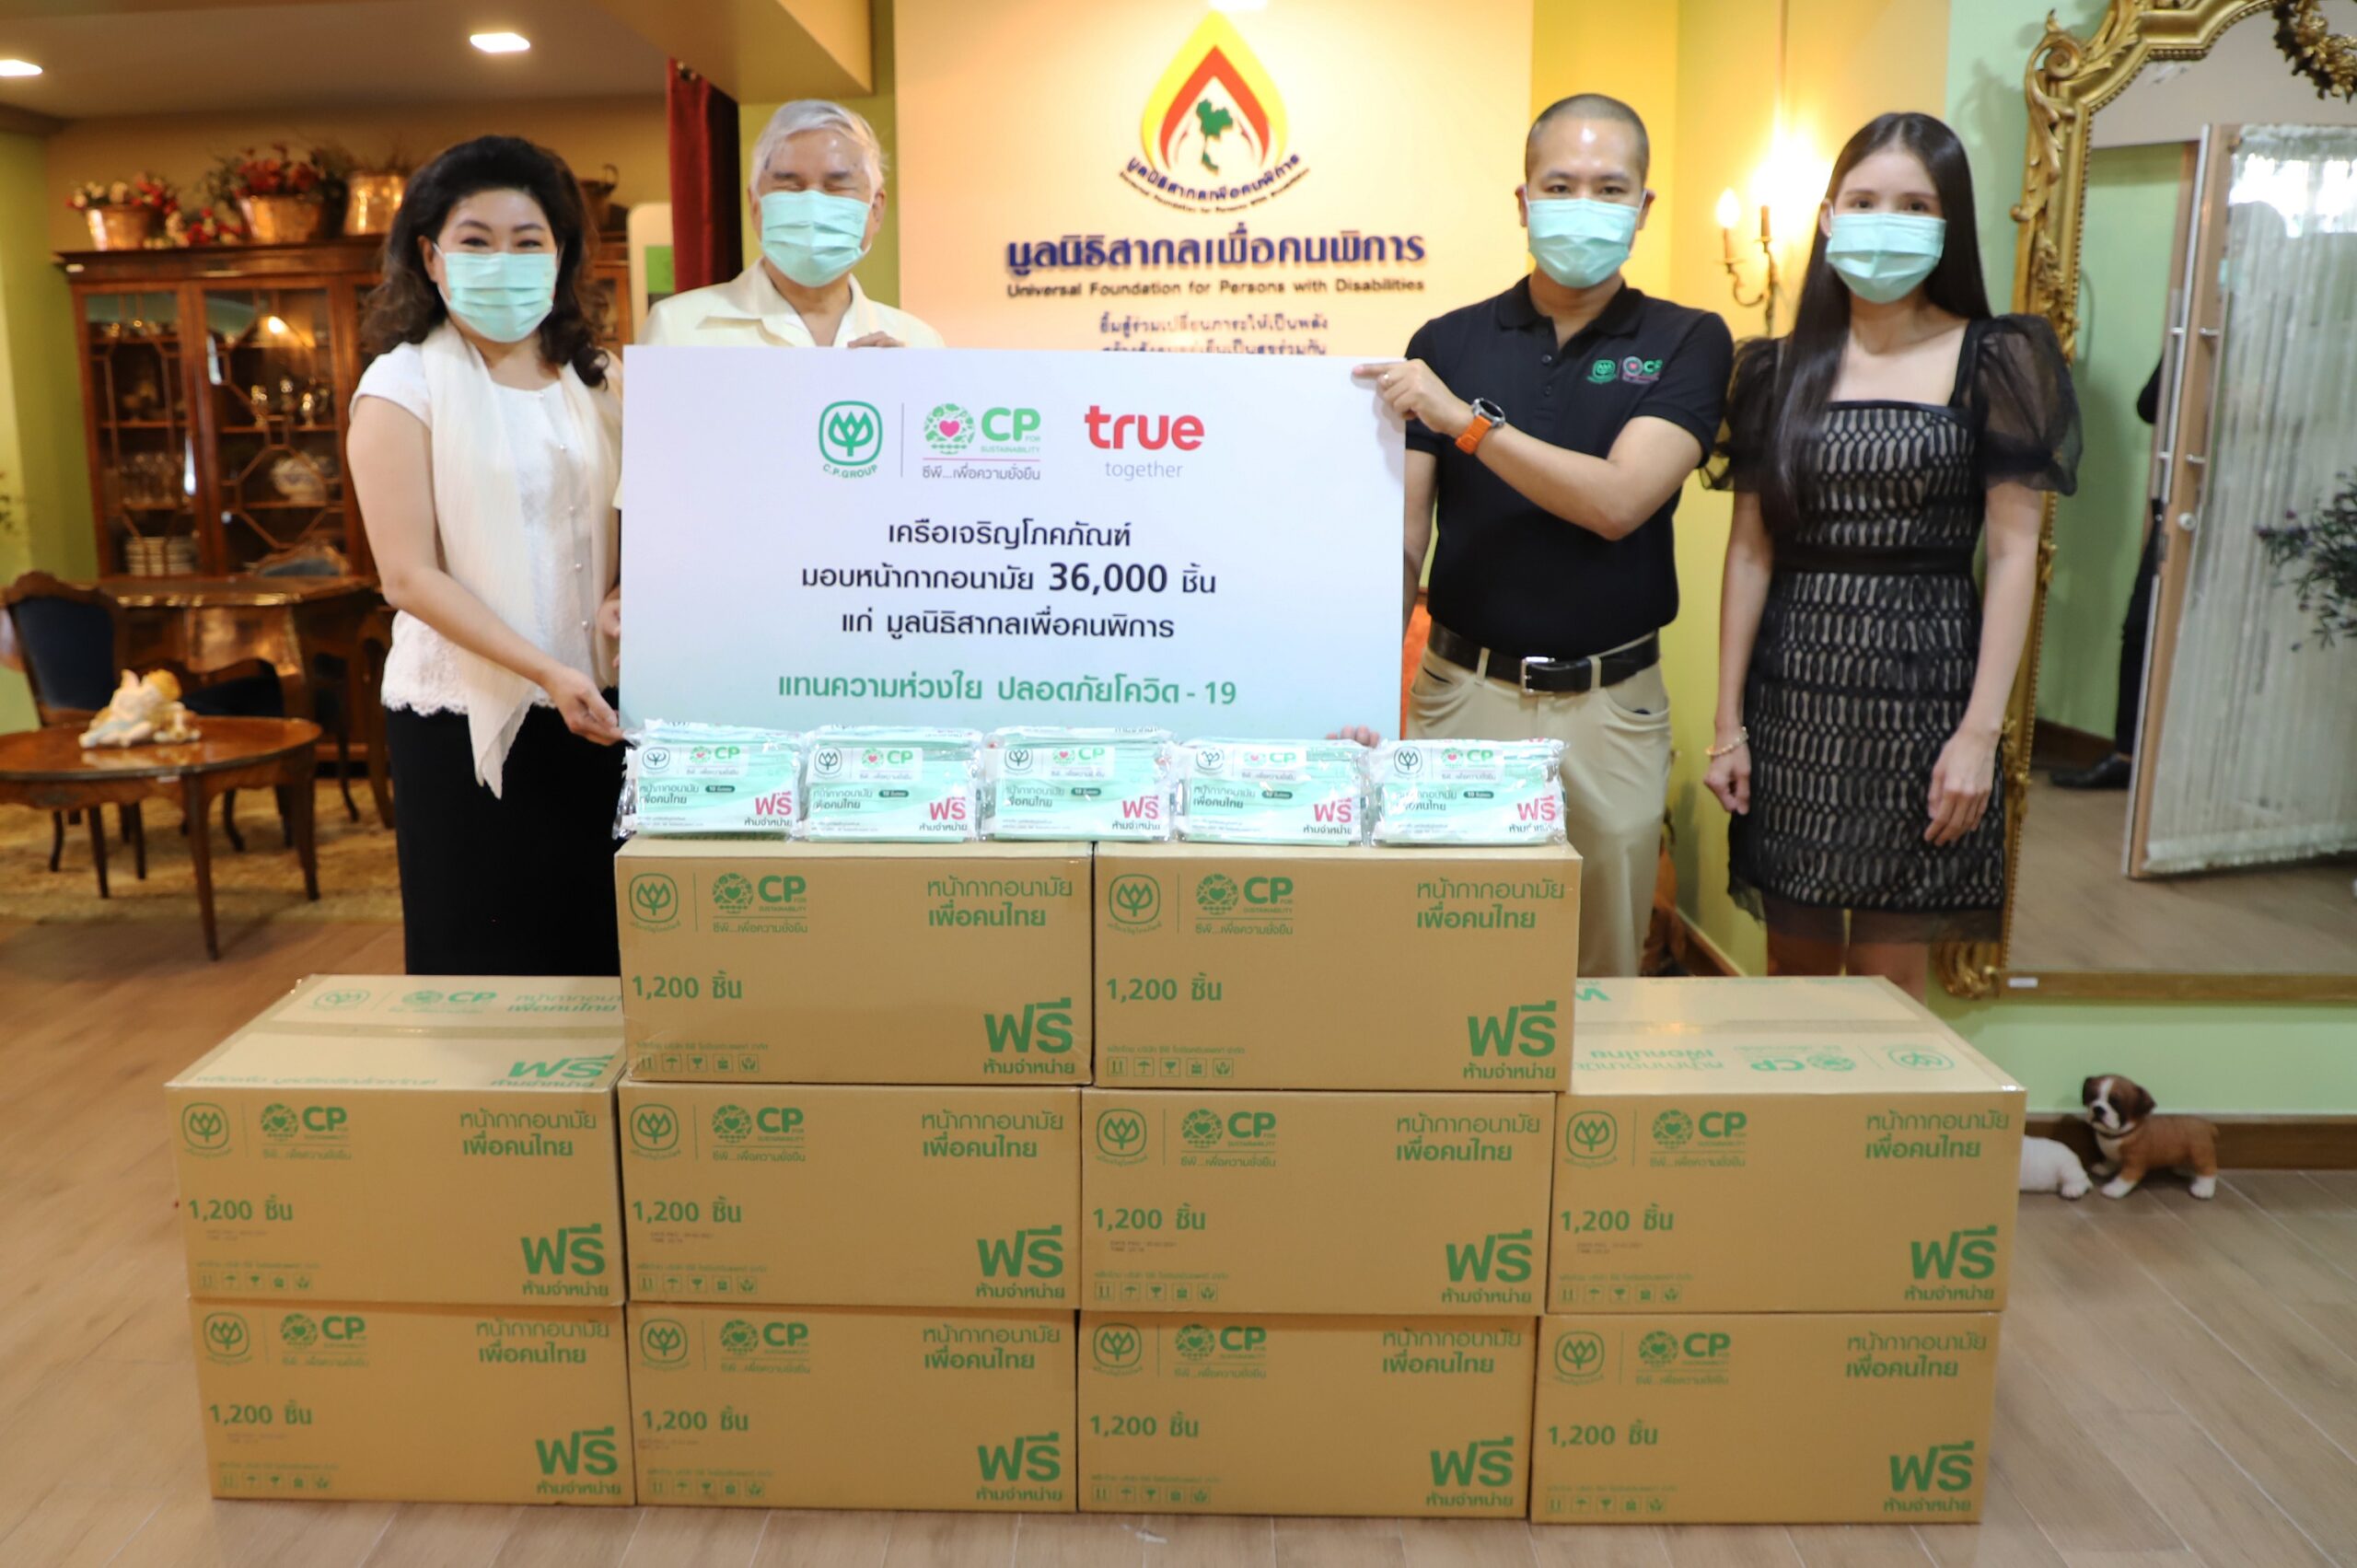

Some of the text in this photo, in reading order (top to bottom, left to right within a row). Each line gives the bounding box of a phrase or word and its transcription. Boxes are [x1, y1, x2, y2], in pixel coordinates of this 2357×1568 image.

[1006, 222, 1425, 274] มูลนิธิสากลเพื่อคนพิการ
[1007, 277, 1425, 297] Universal Foundation for Persons with Disabilities
[981, 407, 1041, 442] CP
[1085, 405, 1205, 451] true
[981, 446, 1040, 454] SUSTAINABILITY
[1105, 460, 1184, 482] together
[888, 518, 1132, 550] เครือเจริญโภคภัณฑ์
[801, 561, 1216, 598] มอบหน้ากากอนามัย 36,000 ชิ้น
[842, 605, 1175, 642] แก่ มูลนิธิสากลเพื่อคนพิการ
[778, 669, 983, 701] แทนความห่วงใย
[714, 747, 740, 760] CP
[888, 750, 913, 764] CP
[1079, 747, 1105, 761] CP
[1270, 751, 1296, 763] CP
[1467, 749, 1493, 762] CP
[755, 791, 792, 816] ฟรี
[930, 796, 966, 820] ฟรี
[1122, 796, 1159, 819] ฟรี
[1314, 797, 1352, 823] ฟรี
[1517, 796, 1556, 822] ฟรี
[759, 876, 807, 903] CP
[927, 876, 1073, 898] หน้ากากอนามัย
[1244, 876, 1294, 905] CP
[1417, 878, 1564, 900] หน้ากากอนามัย
[929, 900, 1046, 926] เพื่อคนไทย
[1417, 901, 1535, 928] เพื่อคนไทย
[632, 971, 742, 1000] 1,200 ชิ้น
[1107, 972, 1223, 1002] 1,200 ชิ้น
[984, 997, 1073, 1054] ฟรี
[1468, 1001, 1557, 1057] ฟรี
[507, 1055, 616, 1078] ฟรี
[983, 1055, 1074, 1074] ห้ามจำหน่าย
[1463, 1062, 1556, 1078] ห้ามจำหน่าย
[303, 1107, 347, 1132] CP
[460, 1109, 597, 1129] หน้ากากอนามัย
[757, 1107, 804, 1133] CP
[922, 1109, 1063, 1131] หน้ากากอนามัย
[1227, 1111, 1277, 1139] CP
[1397, 1111, 1539, 1133] หน้ากากอนามัย
[1698, 1111, 1747, 1139] CP
[1866, 1109, 2009, 1131] หน้ากากอนามัย
[463, 1132, 574, 1156] เพื่อคนไทย
[923, 1132, 1038, 1157] เพื่อคนไทย
[1397, 1135, 1512, 1161] เพื่อคนไทย
[1865, 1133, 1980, 1158] เพื่อคนไทย
[188, 1194, 293, 1223] 1,200 ชิ้น
[632, 1196, 742, 1224] 1,200 ชิ้น
[1092, 1202, 1205, 1231] 1,200 ชิ้น
[1560, 1203, 1674, 1234] 1,200 ชิ้น
[521, 1224, 606, 1276] ฟรี
[977, 1225, 1063, 1278] ฟรี
[1446, 1229, 1533, 1283] ฟรี
[1910, 1225, 1998, 1281] ฟรี
[522, 1279, 609, 1296] ห้ามจำหน่าย
[976, 1281, 1065, 1299] ห้ามจำหน่าย
[1442, 1286, 1532, 1304] ห้ามจำหน่าย
[1904, 1283, 1994, 1301] ห้ามจำหน่าย
[322, 1316, 365, 1341] CP
[476, 1318, 610, 1338] หน้ากากอนามัย
[763, 1322, 808, 1347] CP
[923, 1323, 1061, 1343] หน้ากากอนามัย
[1219, 1326, 1266, 1352] CP
[1383, 1328, 1521, 1348] หน้ากากอนามัย
[479, 1341, 586, 1364] เพื่อคนไทย
[1683, 1332, 1731, 1358] CP
[1847, 1330, 1987, 1353] หน้ากากอนามัย
[924, 1346, 1035, 1369] เพื่อคนไทย
[1383, 1351, 1494, 1374] เพื่อคนไทย
[1846, 1355, 1958, 1377] เพื่อคนไทย
[209, 1400, 312, 1426] 1,200 ชิ้น
[642, 1405, 749, 1433] 1,200 ชิ้น
[1090, 1411, 1199, 1437] 1,200 ชิ้น
[1548, 1419, 1658, 1447] 1,200 ชิ้น
[535, 1426, 618, 1477] ฟรี
[977, 1432, 1061, 1482] ฟรี
[1431, 1436, 1514, 1487] ฟรี
[1889, 1441, 1975, 1493] ฟรี
[536, 1480, 621, 1496] ห้ามจำหน่าย
[976, 1485, 1062, 1502] ห้ามจำหน่าย
[1425, 1491, 1513, 1507] ห้ามจำหน่าย
[1884, 1496, 1972, 1513] ห้ามจำหน่าย
